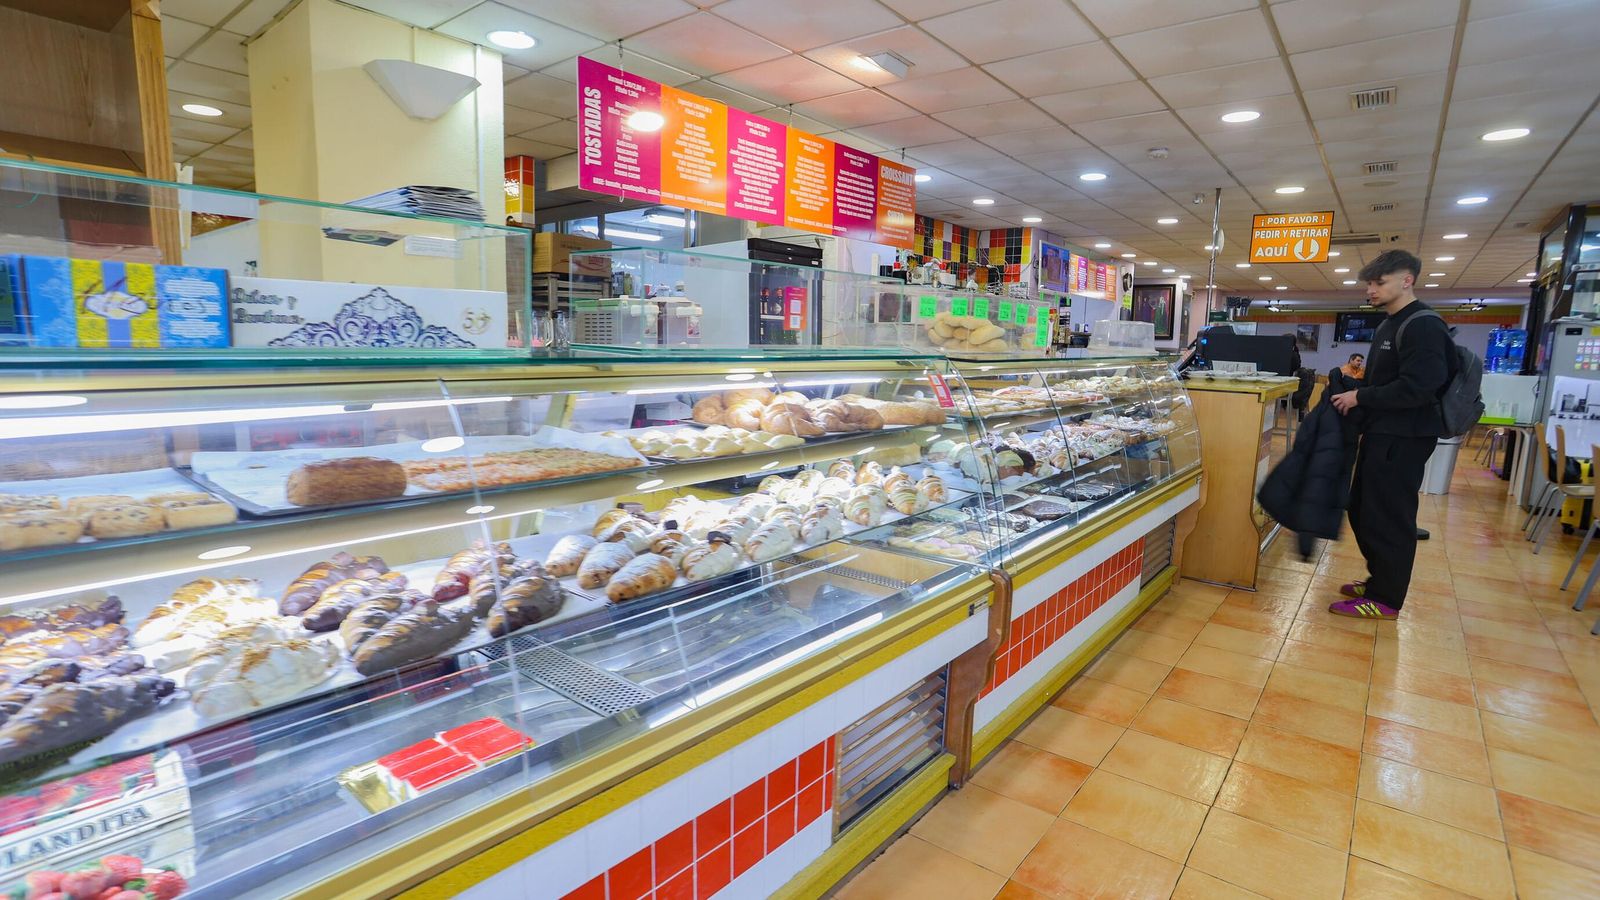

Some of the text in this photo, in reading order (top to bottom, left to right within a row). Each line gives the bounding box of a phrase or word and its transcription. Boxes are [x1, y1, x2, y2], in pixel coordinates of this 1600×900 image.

[584, 87, 602, 166] TOSTADAS
[881, 166, 913, 185] CROISSANT
[1289, 216, 1318, 224] FAVOR
[1255, 228, 1328, 239] PEDIR Y RETIRAR
[1255, 243, 1288, 257] AQUÍ
